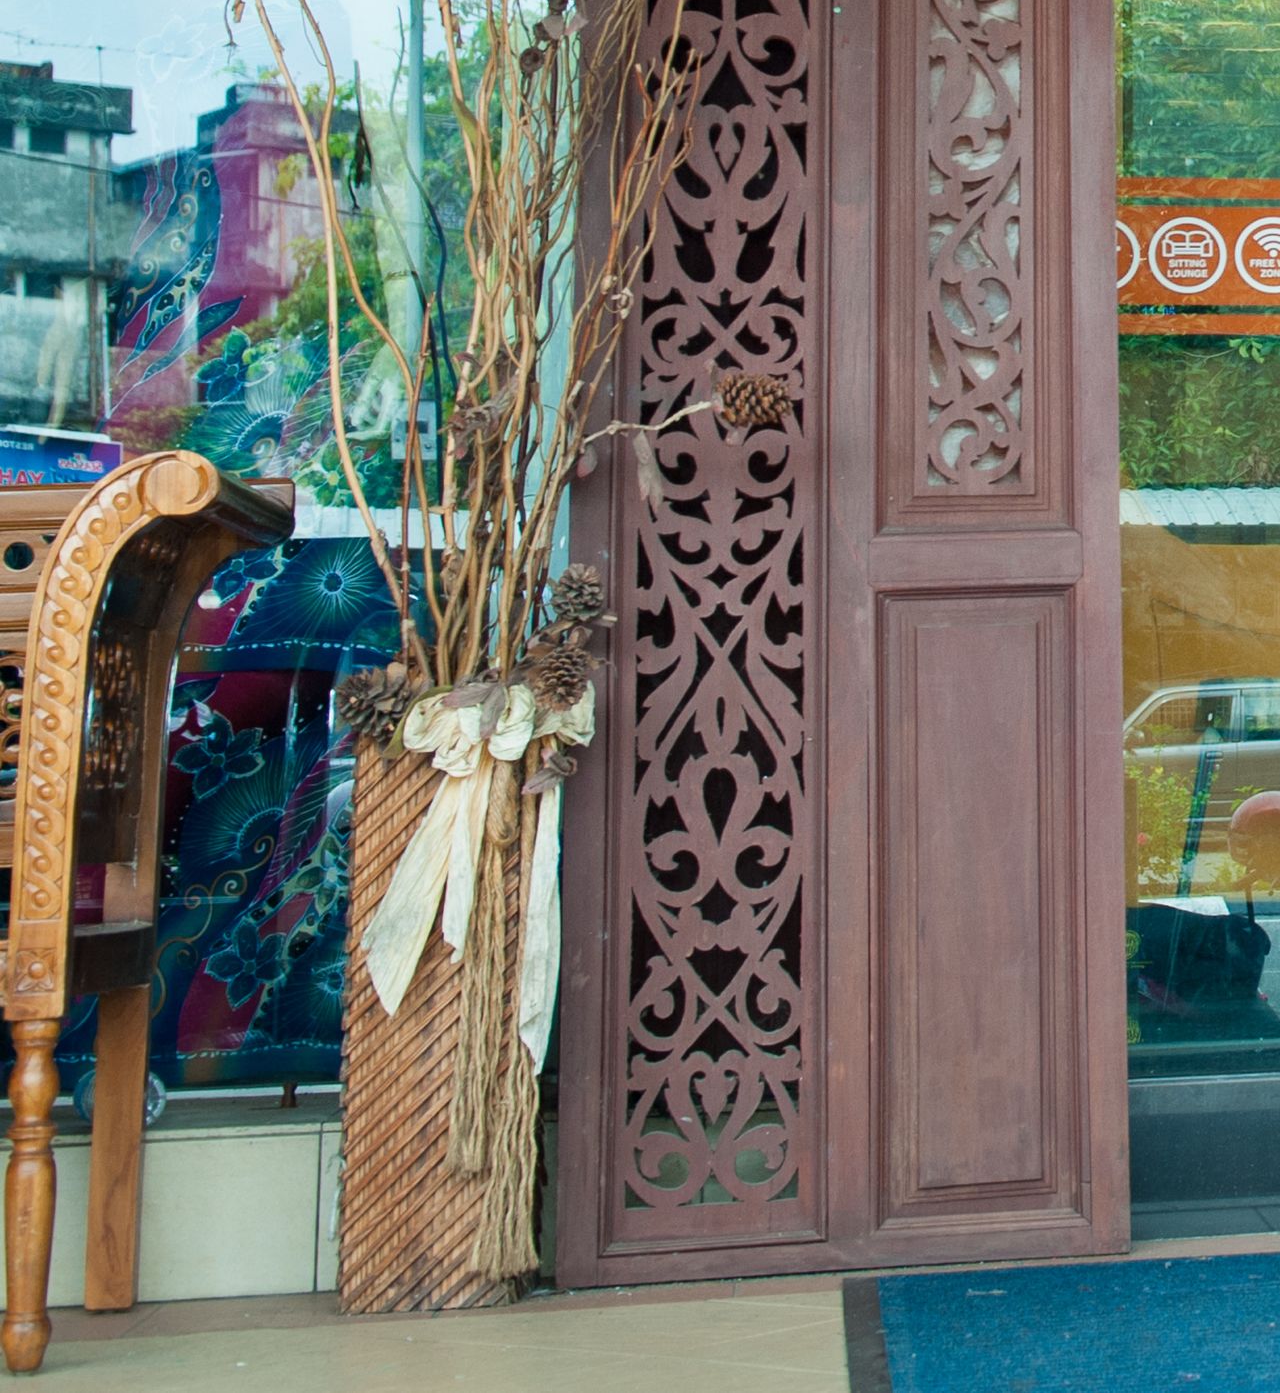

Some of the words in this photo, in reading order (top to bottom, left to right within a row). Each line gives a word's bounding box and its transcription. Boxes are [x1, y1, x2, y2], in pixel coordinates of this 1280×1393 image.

[1167, 259, 1207, 269] SITTING
[1249, 259, 1275, 269] FREE
[1167, 269, 1208, 279] LOUNGE
